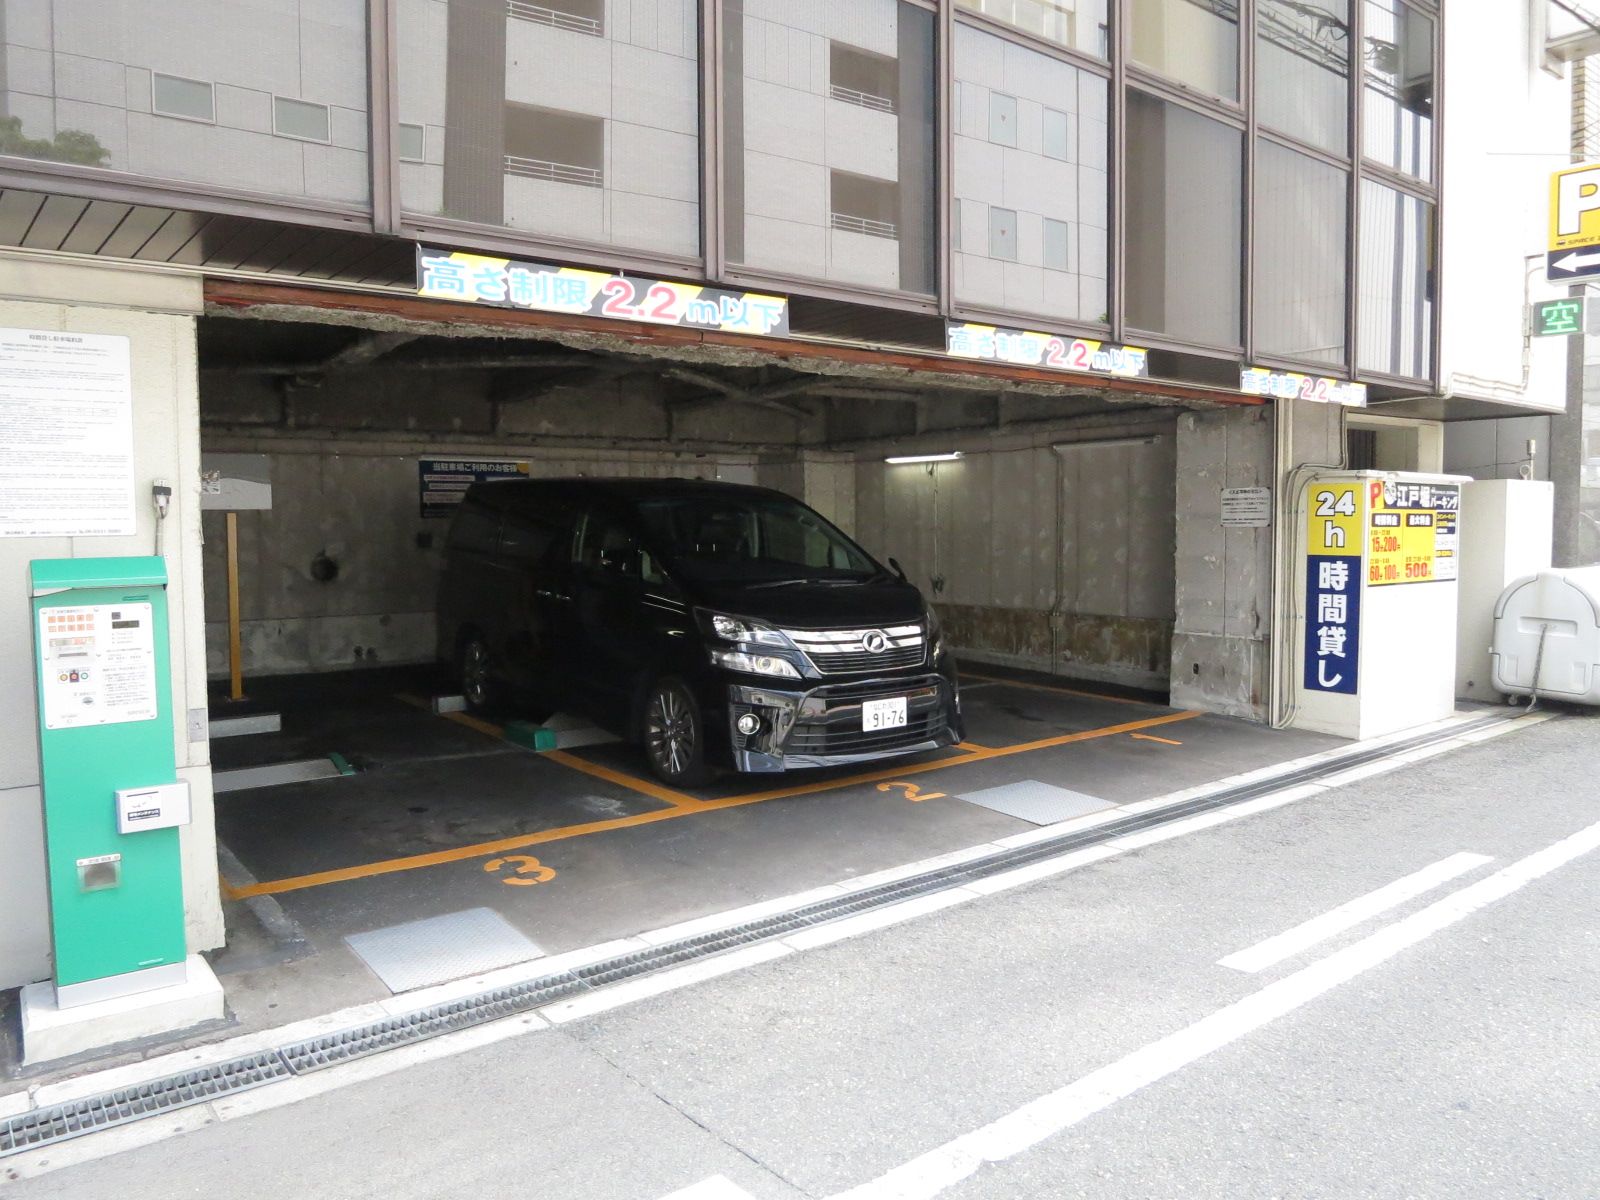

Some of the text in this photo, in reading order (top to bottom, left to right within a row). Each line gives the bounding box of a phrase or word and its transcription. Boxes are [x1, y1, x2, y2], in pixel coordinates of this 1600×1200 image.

[1557, 168, 1600, 236] P
[1541, 302, 1579, 335] 空
[1315, 491, 1356, 516] 24
[1370, 482, 1381, 509] P
[1324, 520, 1346, 548] h
[1317, 561, 1349, 688] 時間貸し
[483, 855, 557, 886] 3
